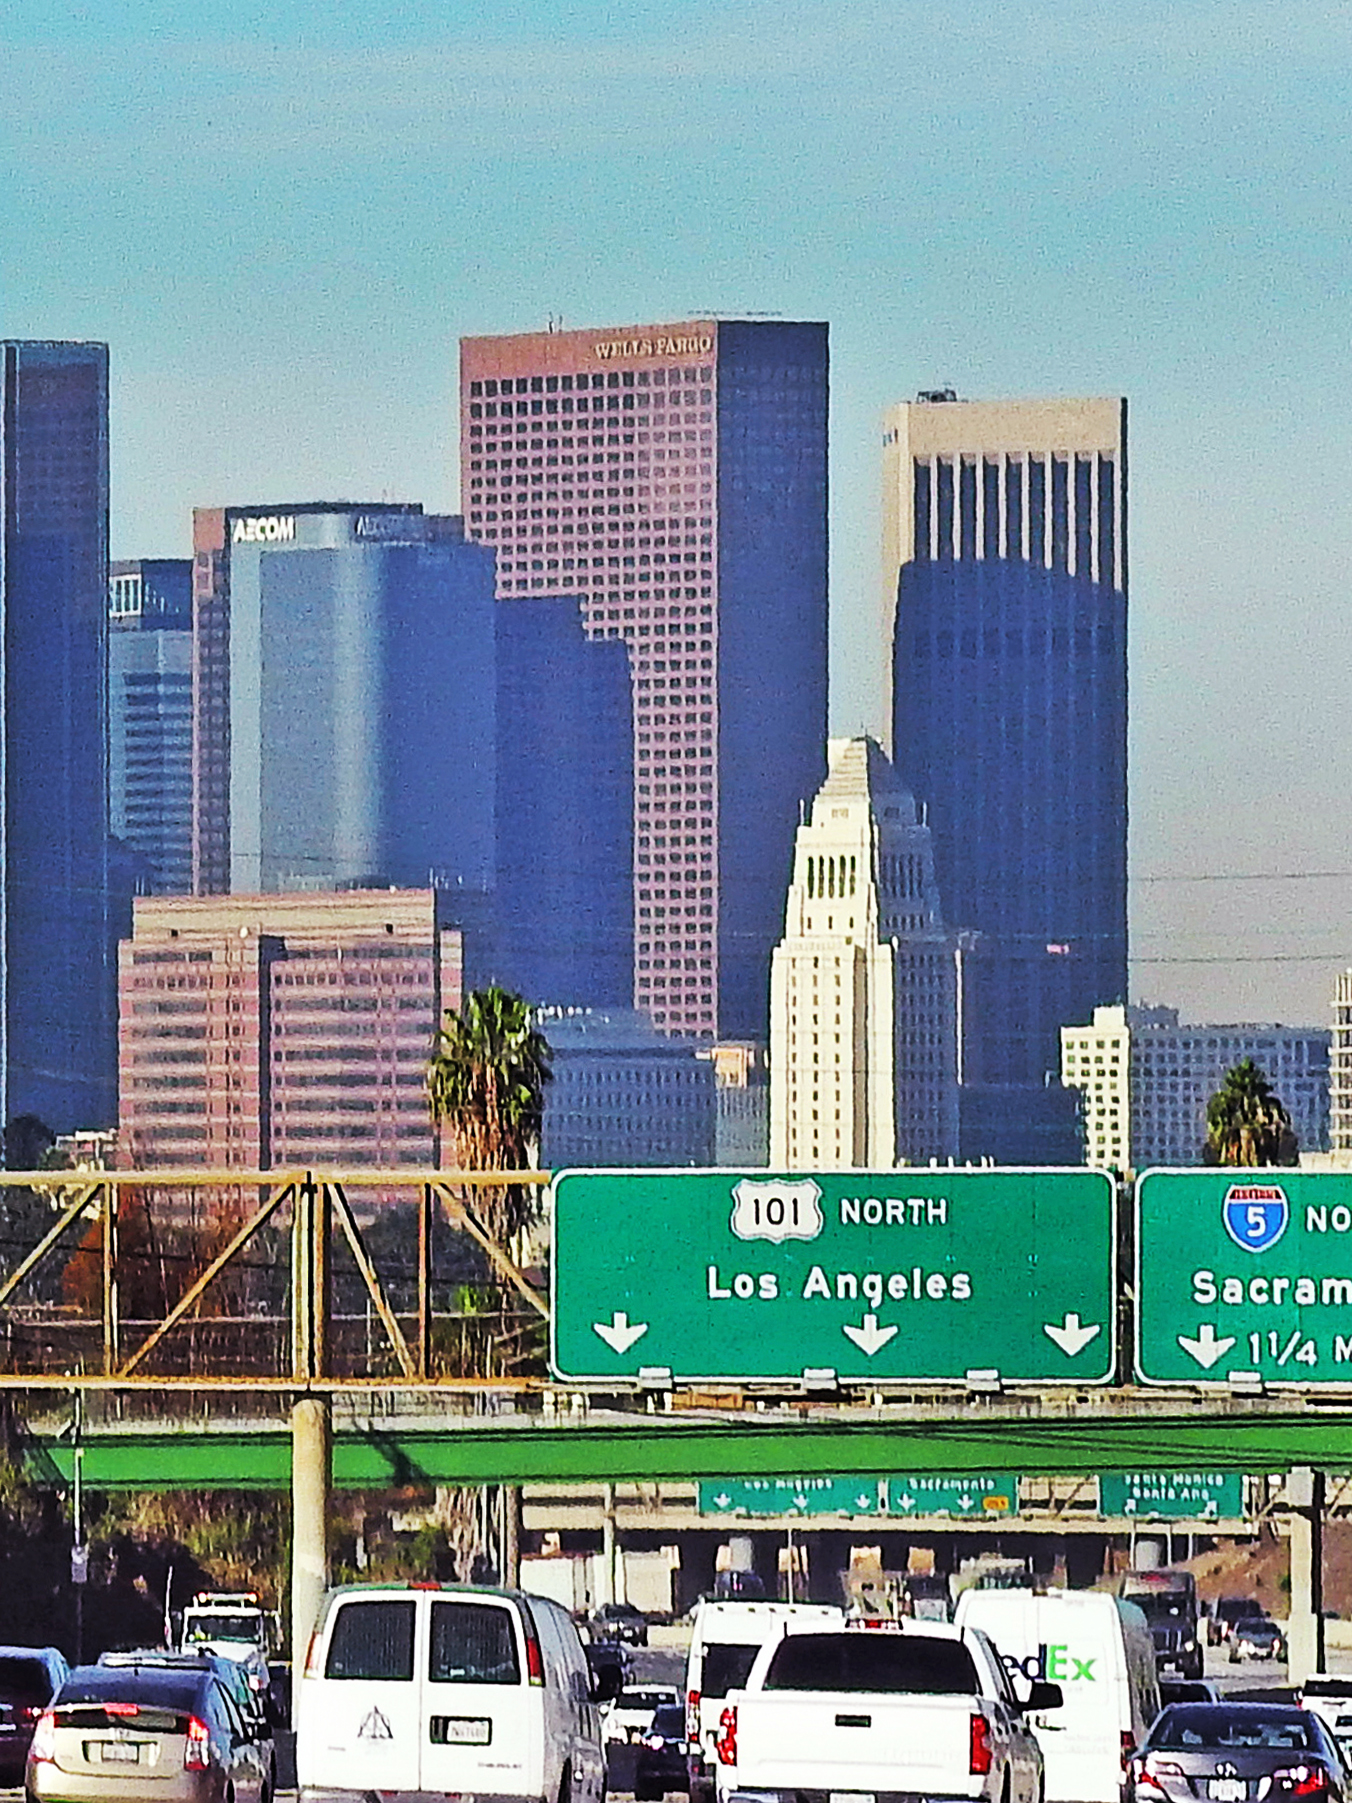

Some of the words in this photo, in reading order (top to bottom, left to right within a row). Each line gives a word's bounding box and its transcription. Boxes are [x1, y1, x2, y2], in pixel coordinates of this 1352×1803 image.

[594, 339, 652, 359] WELLS
[656, 336, 712, 354] FARGO
[233, 516, 295, 543] AECOM
[753, 1198, 798, 1225] 101
[840, 1198, 947, 1224] NORTH
[1247, 1206, 1267, 1237] 5
[707, 1265, 779, 1300] Los
[802, 1266, 972, 1309] Angeles
[1002, 1644, 1096, 1681] edEx
